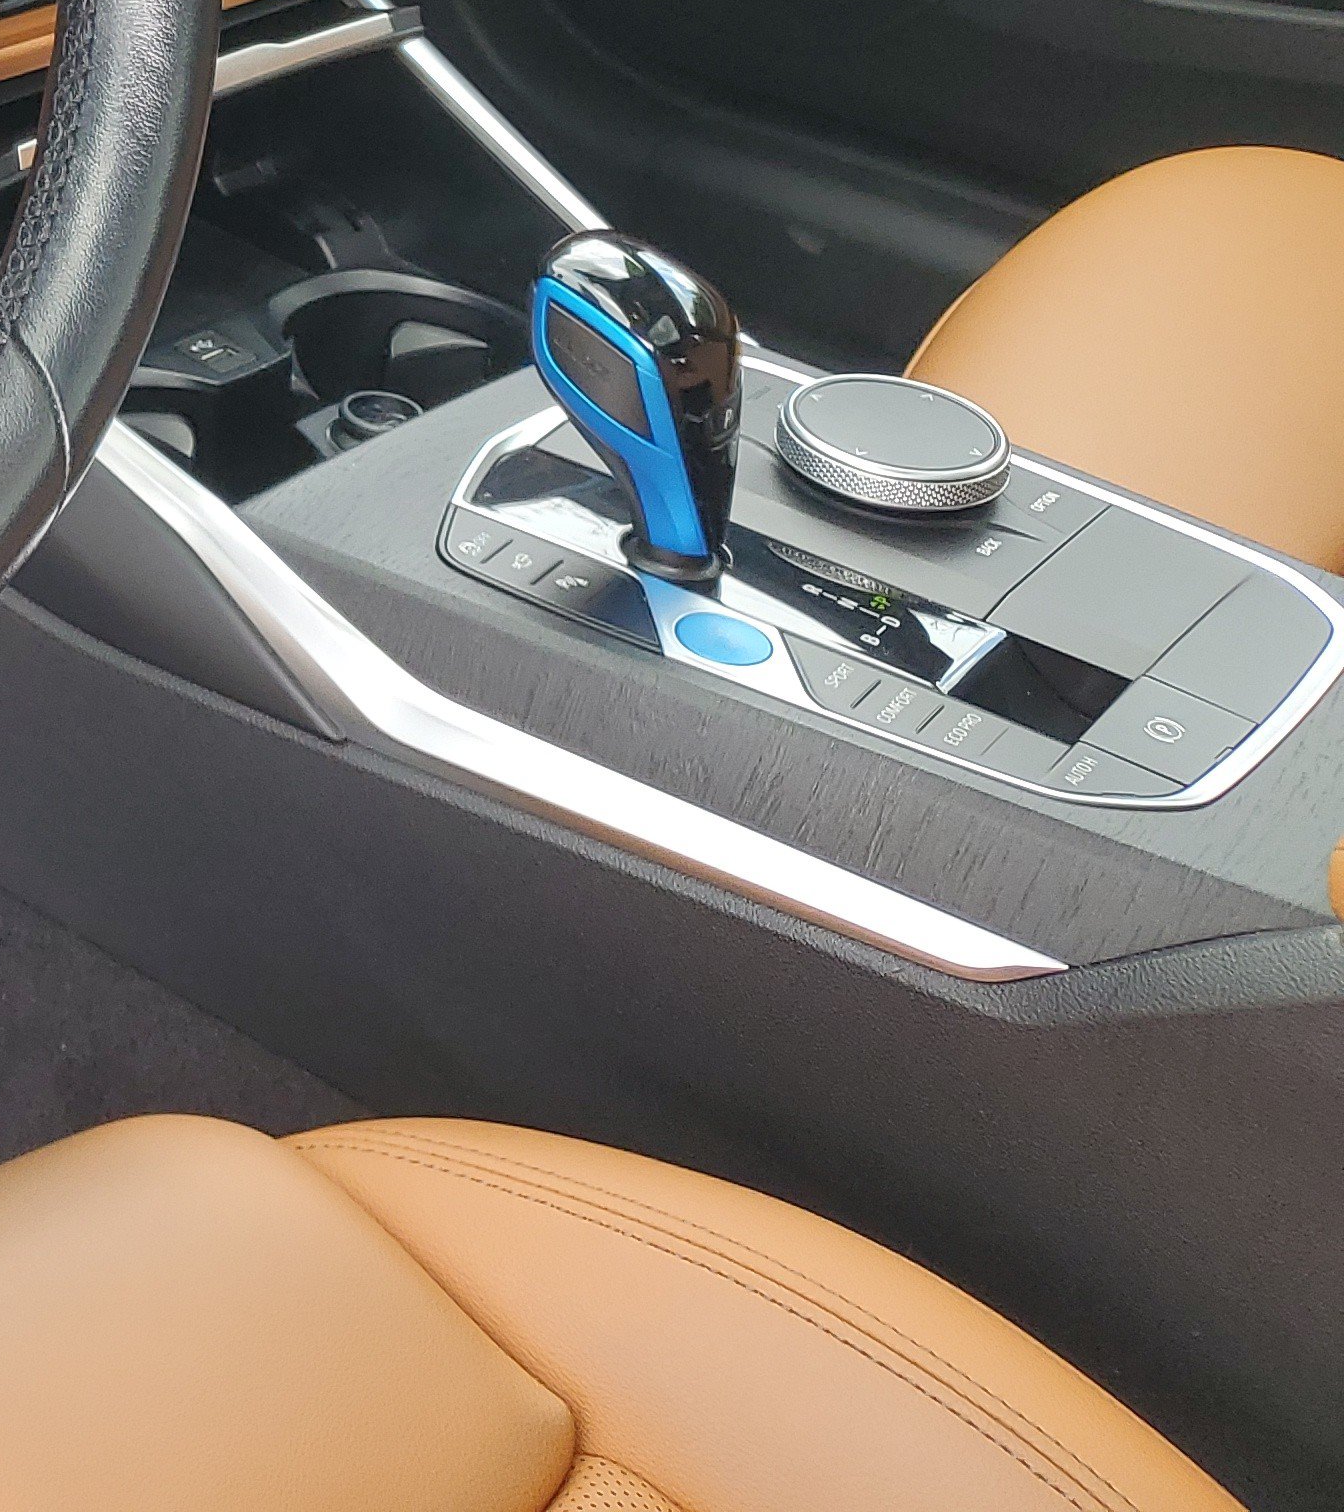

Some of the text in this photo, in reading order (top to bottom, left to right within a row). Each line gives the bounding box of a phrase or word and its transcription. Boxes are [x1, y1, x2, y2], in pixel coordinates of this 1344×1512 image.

[859, 633, 880, 647] B
[824, 662, 855, 688] SPORT
[876, 687, 918, 724] COMFORT
[943, 712, 984, 748] ECO PRO
[1064, 755, 1099, 787] AUTO H
